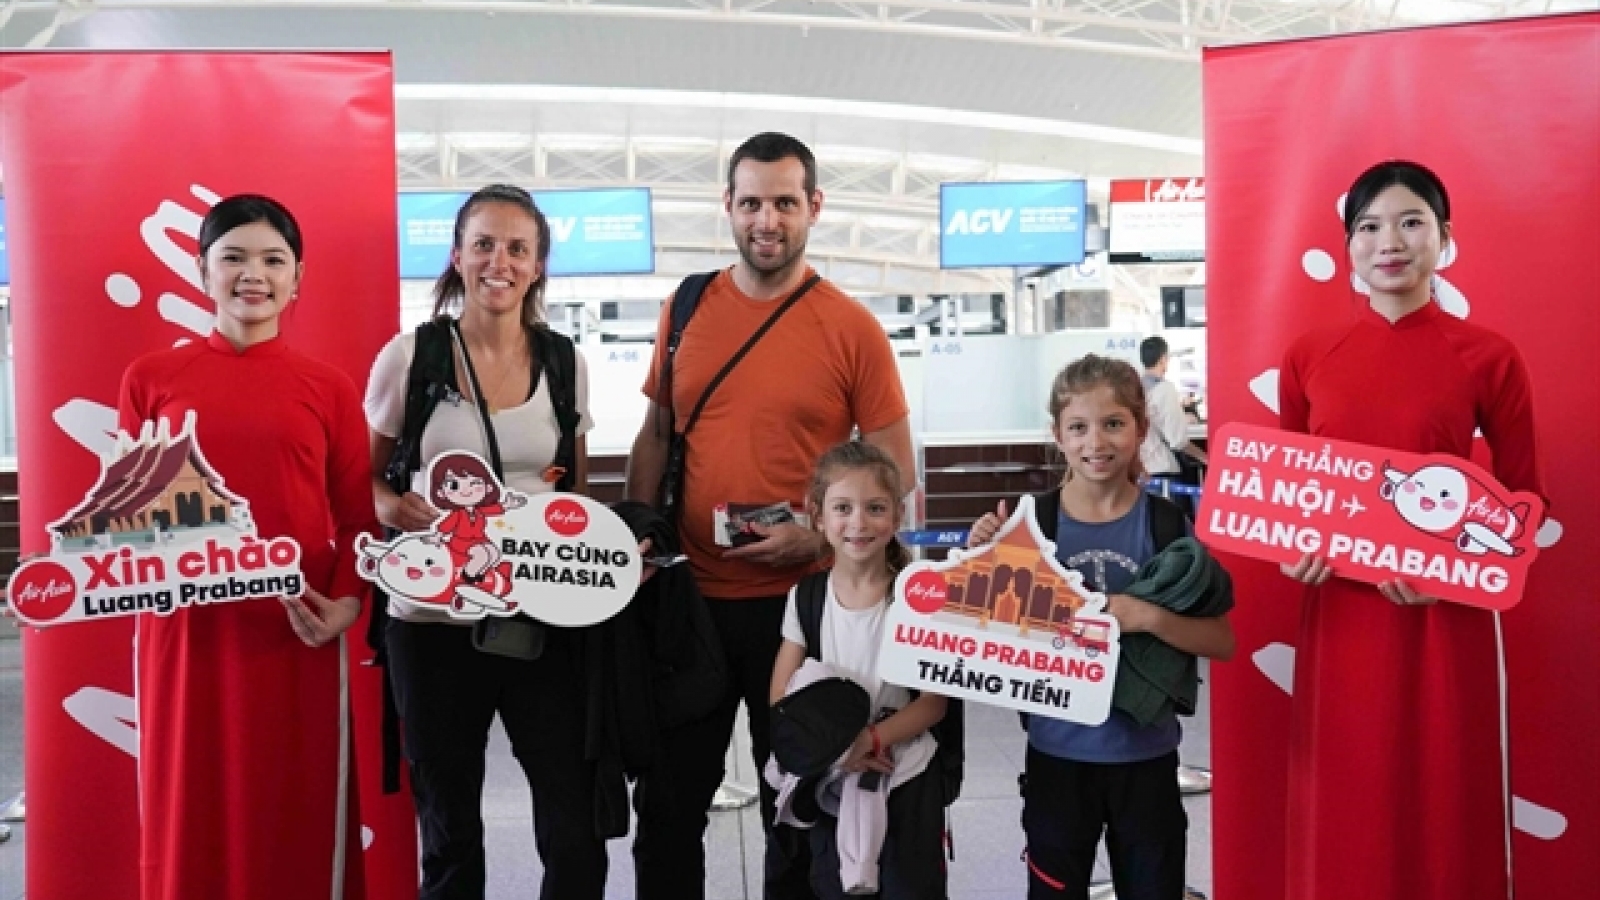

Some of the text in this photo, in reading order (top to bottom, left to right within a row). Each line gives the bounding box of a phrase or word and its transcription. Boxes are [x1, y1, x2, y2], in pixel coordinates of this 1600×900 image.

[945, 207, 1014, 235] AGV
[1225, 436, 1278, 463] BAY
[1217, 467, 1336, 518] HÀ NỘI
[82, 536, 297, 591] Xin chào
[501, 537, 630, 568] BAY CÙNG
[1209, 509, 1510, 594] LUANG PRABANG
[83, 574, 301, 616] Luang Prabang
[514, 562, 616, 590] AIRASIA
[894, 624, 1105, 683] LUANG PRABANG
[917, 657, 1071, 709] THẲNG TIẾN!
